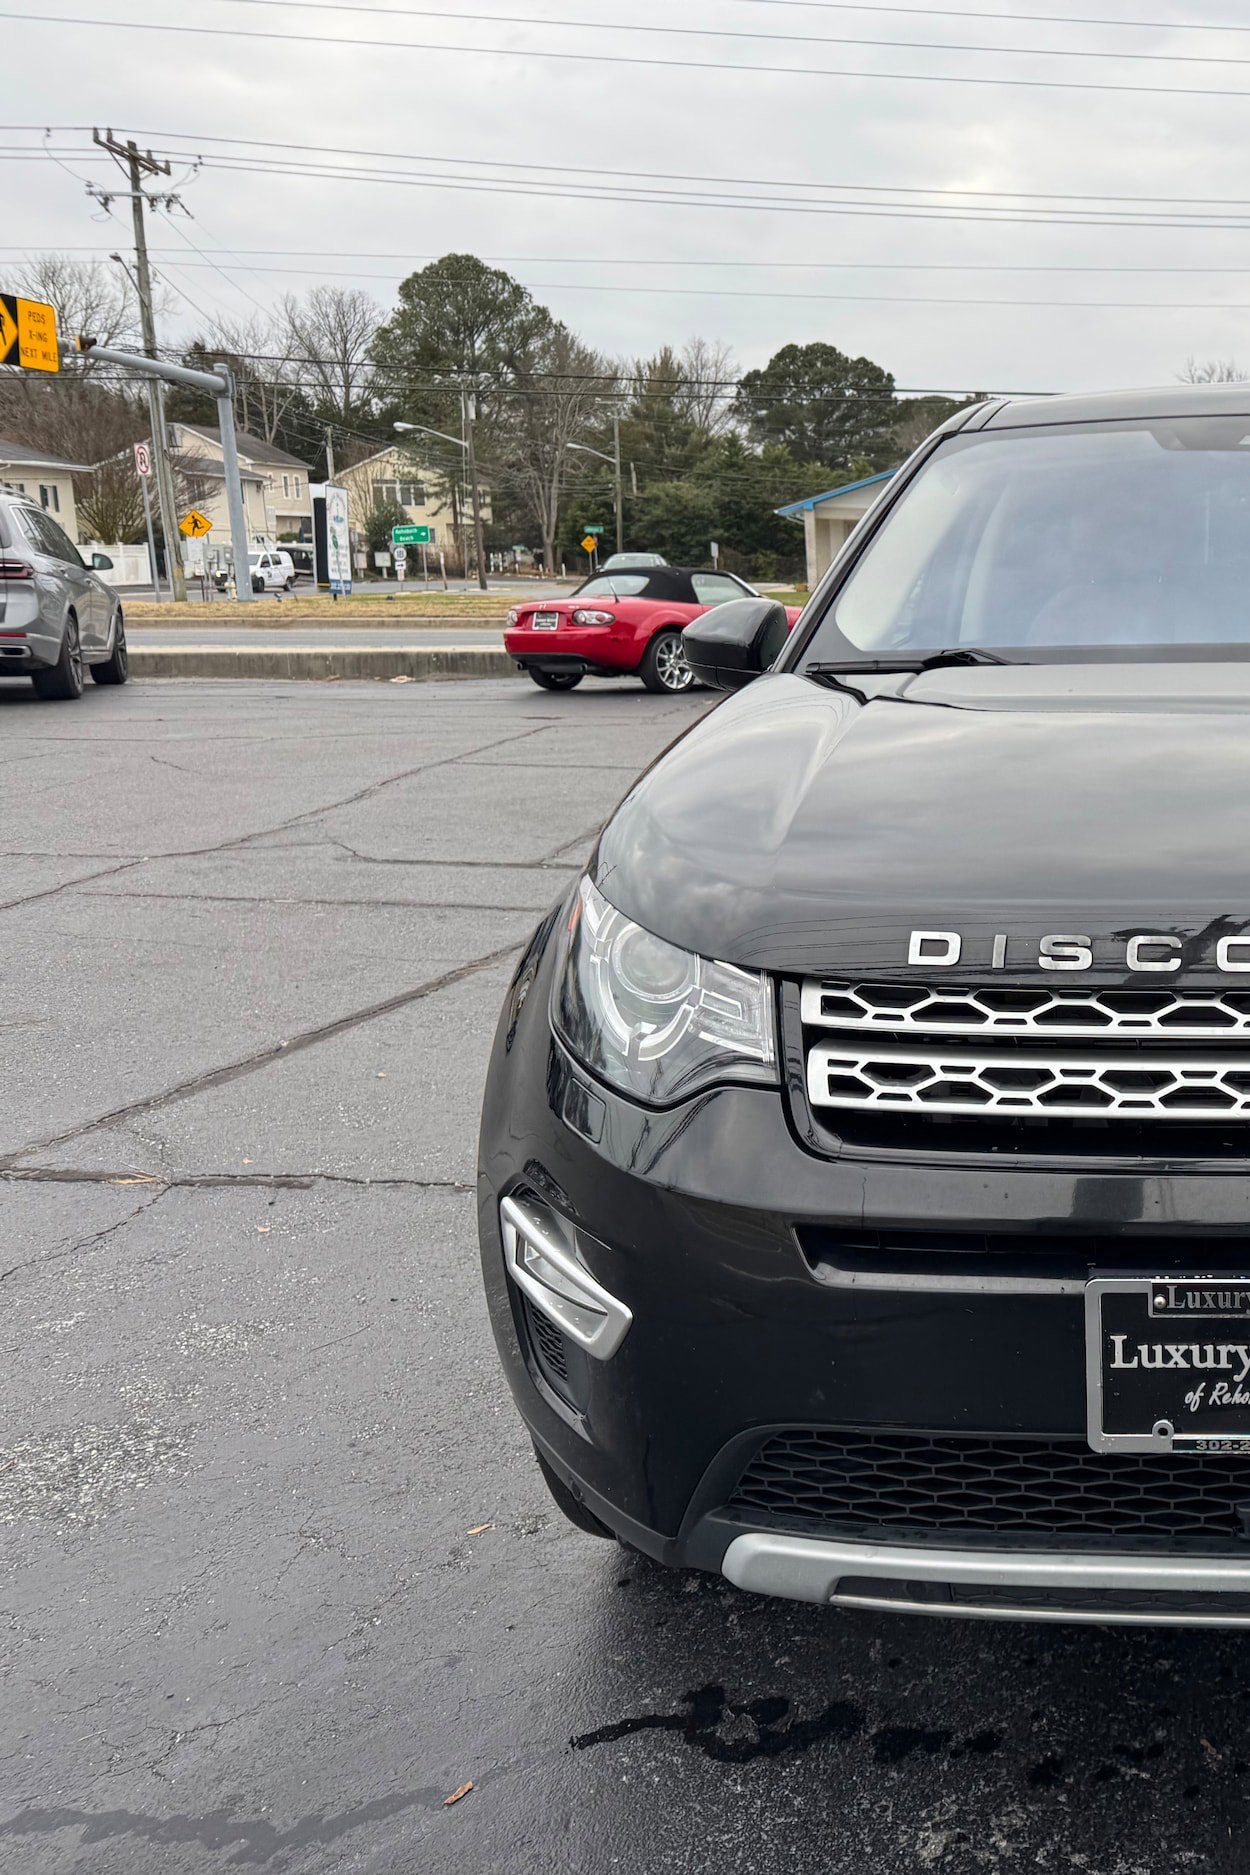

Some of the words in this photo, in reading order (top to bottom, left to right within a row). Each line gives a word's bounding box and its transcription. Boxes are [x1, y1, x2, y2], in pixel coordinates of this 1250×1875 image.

[28, 311, 46, 325] PEDS
[29, 330, 48, 343] X-ING
[21, 346, 37, 359] NEXT
[42, 350, 57, 363] MILE
[1184, 1383, 1206, 1412] of
